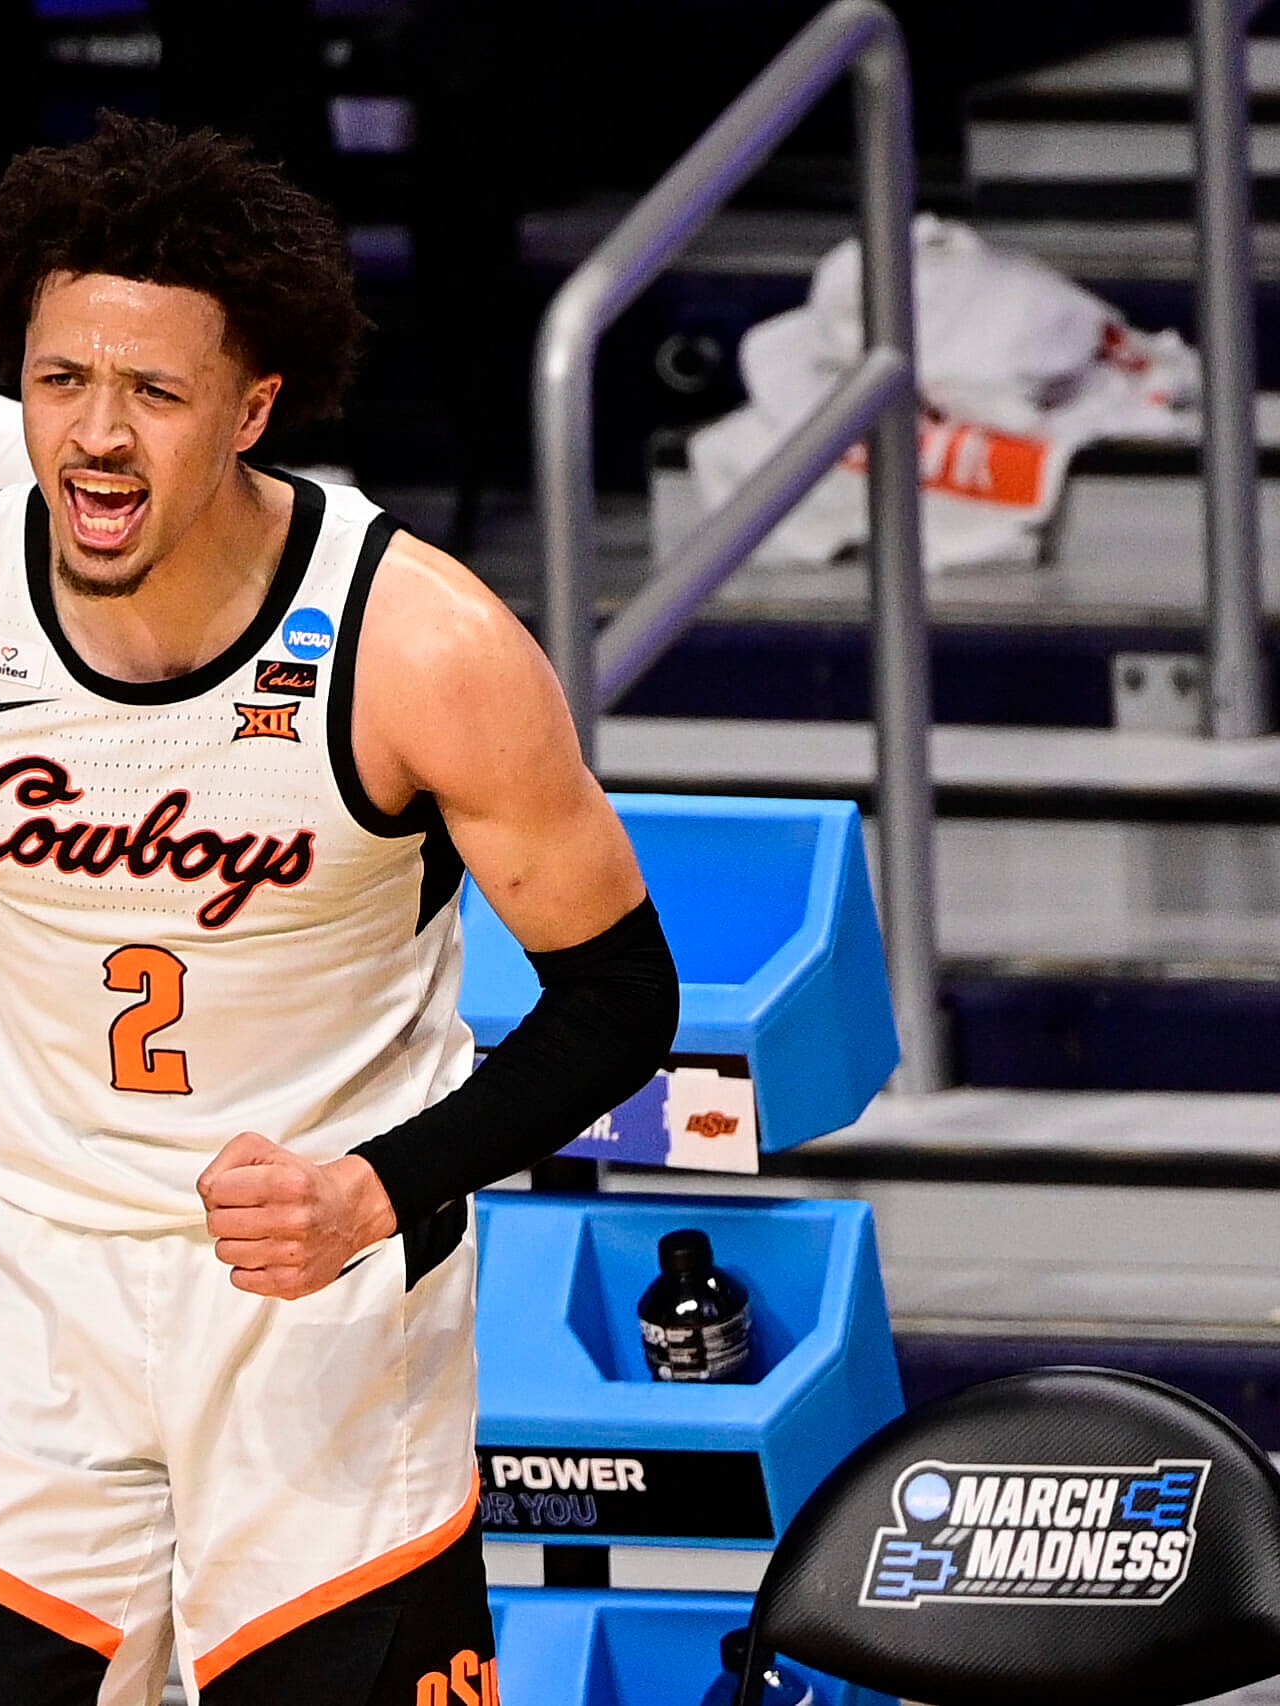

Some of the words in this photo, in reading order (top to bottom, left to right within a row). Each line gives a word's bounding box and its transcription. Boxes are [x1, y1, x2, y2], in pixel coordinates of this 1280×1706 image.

[288, 630, 332, 650] NCAA
[256, 662, 315, 691] Eddie
[237, 706, 297, 739] XII
[103, 944, 193, 1097] 2
[491, 1455, 648, 1492] POWER
[520, 1492, 598, 1527] YOU
[949, 1476, 1119, 1527] MARCH
[965, 1530, 1187, 1581] MADNESS
